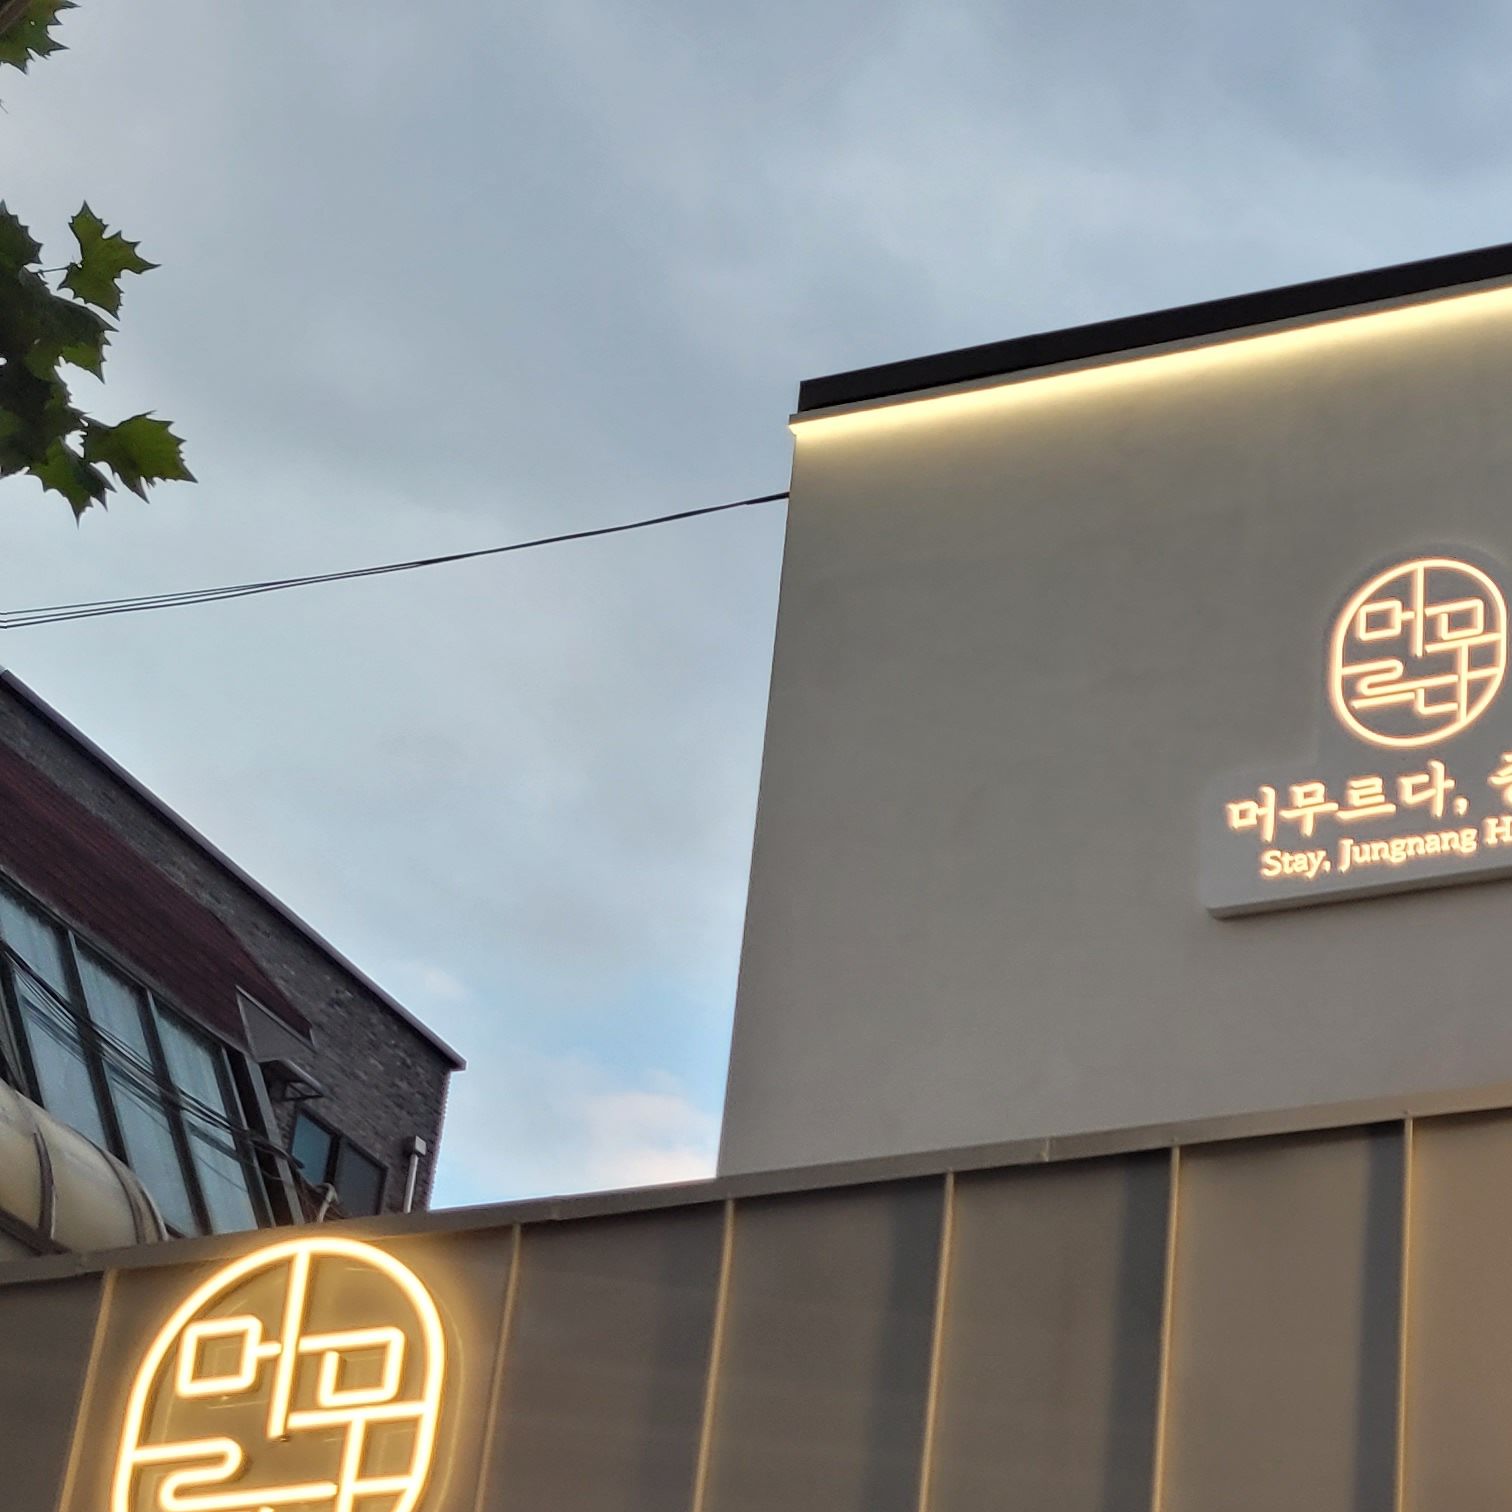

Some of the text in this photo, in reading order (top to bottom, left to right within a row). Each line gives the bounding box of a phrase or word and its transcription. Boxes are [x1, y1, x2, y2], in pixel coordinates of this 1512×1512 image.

[1225, 759, 1469, 843] 머무르다,
[1260, 848, 1332, 880] Stay,
[1337, 827, 1479, 875] Jungnang
